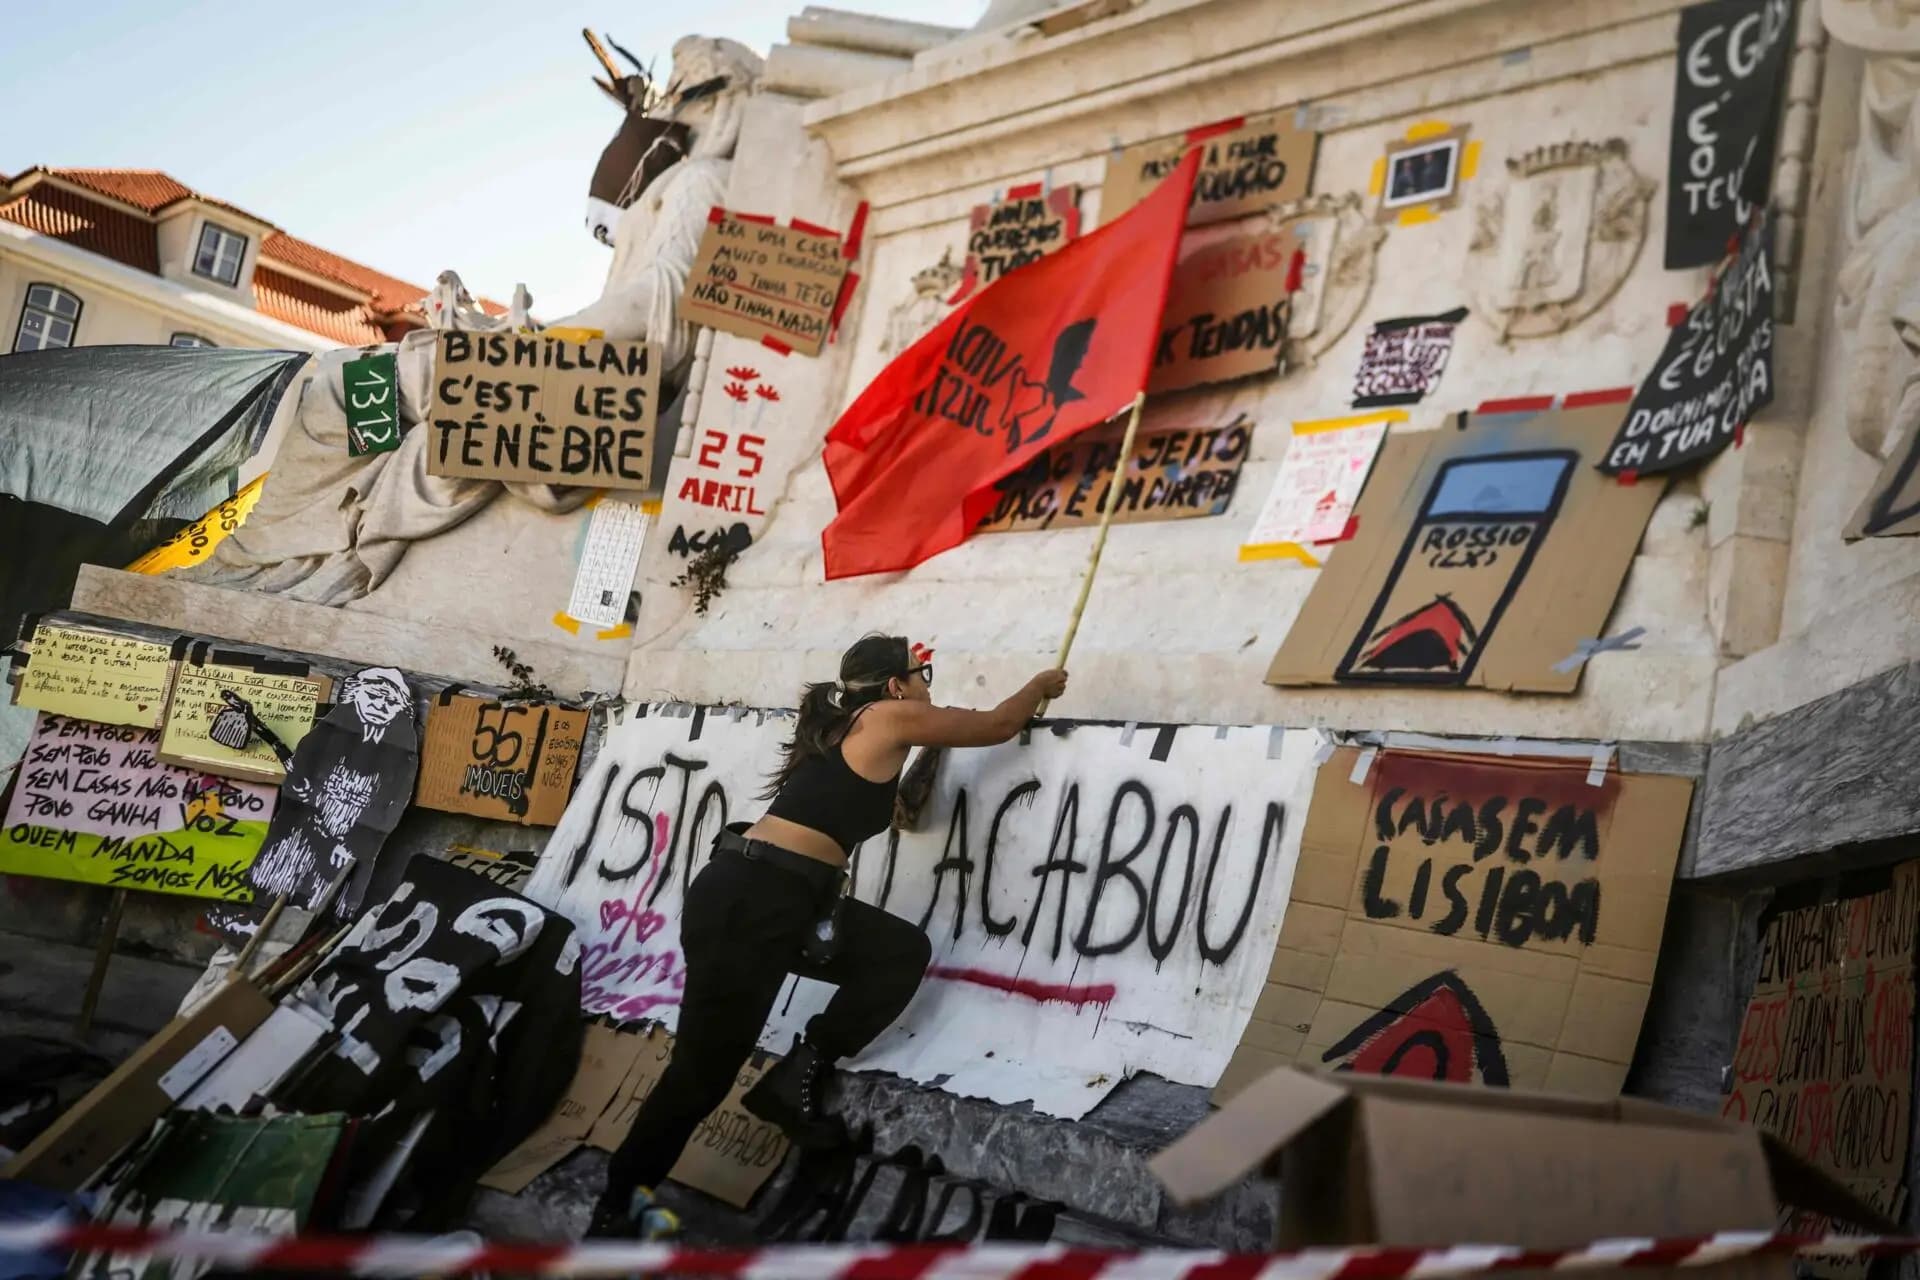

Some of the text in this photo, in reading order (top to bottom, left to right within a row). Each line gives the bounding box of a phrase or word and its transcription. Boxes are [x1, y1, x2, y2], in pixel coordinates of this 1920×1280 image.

[714, 245, 768, 265] MUITO
[717, 218, 841, 261] ERA UMA CASA
[693, 283, 823, 334] NÃO TINHA NADA
[708, 263, 833, 309] NÃO TINHA TETO
[443, 330, 649, 377] BISMILLAH
[438, 374, 647, 423] C'EST LES
[434, 412, 647, 481] TÉNÈBRE
[698, 429, 766, 478] 25
[1608, 440, 1651, 478] EM
[1657, 413, 1717, 461] TUA
[678, 477, 765, 516] ABRIL
[1421, 525, 1532, 555] ROSSIO
[1428, 548, 1498, 569] (LX)
[38, 714, 89, 741] SEM
[94, 719, 136, 743] POVO
[472, 702, 528, 767] 55
[29, 743, 70, 765] SEM
[71, 743, 112, 767] POVO
[25, 767, 69, 791] SEM
[72, 769, 133, 797] CASAS
[135, 774, 178, 799] NÃO
[213, 779, 265, 813] POVO
[463, 762, 526, 800] IMÓVEIS
[23, 791, 245, 838] POVO GANHA VOZ
[91, 835, 196, 866] MANDA
[918, 778, 1285, 968] ACABOU
[109, 863, 196, 890] SOMOS
